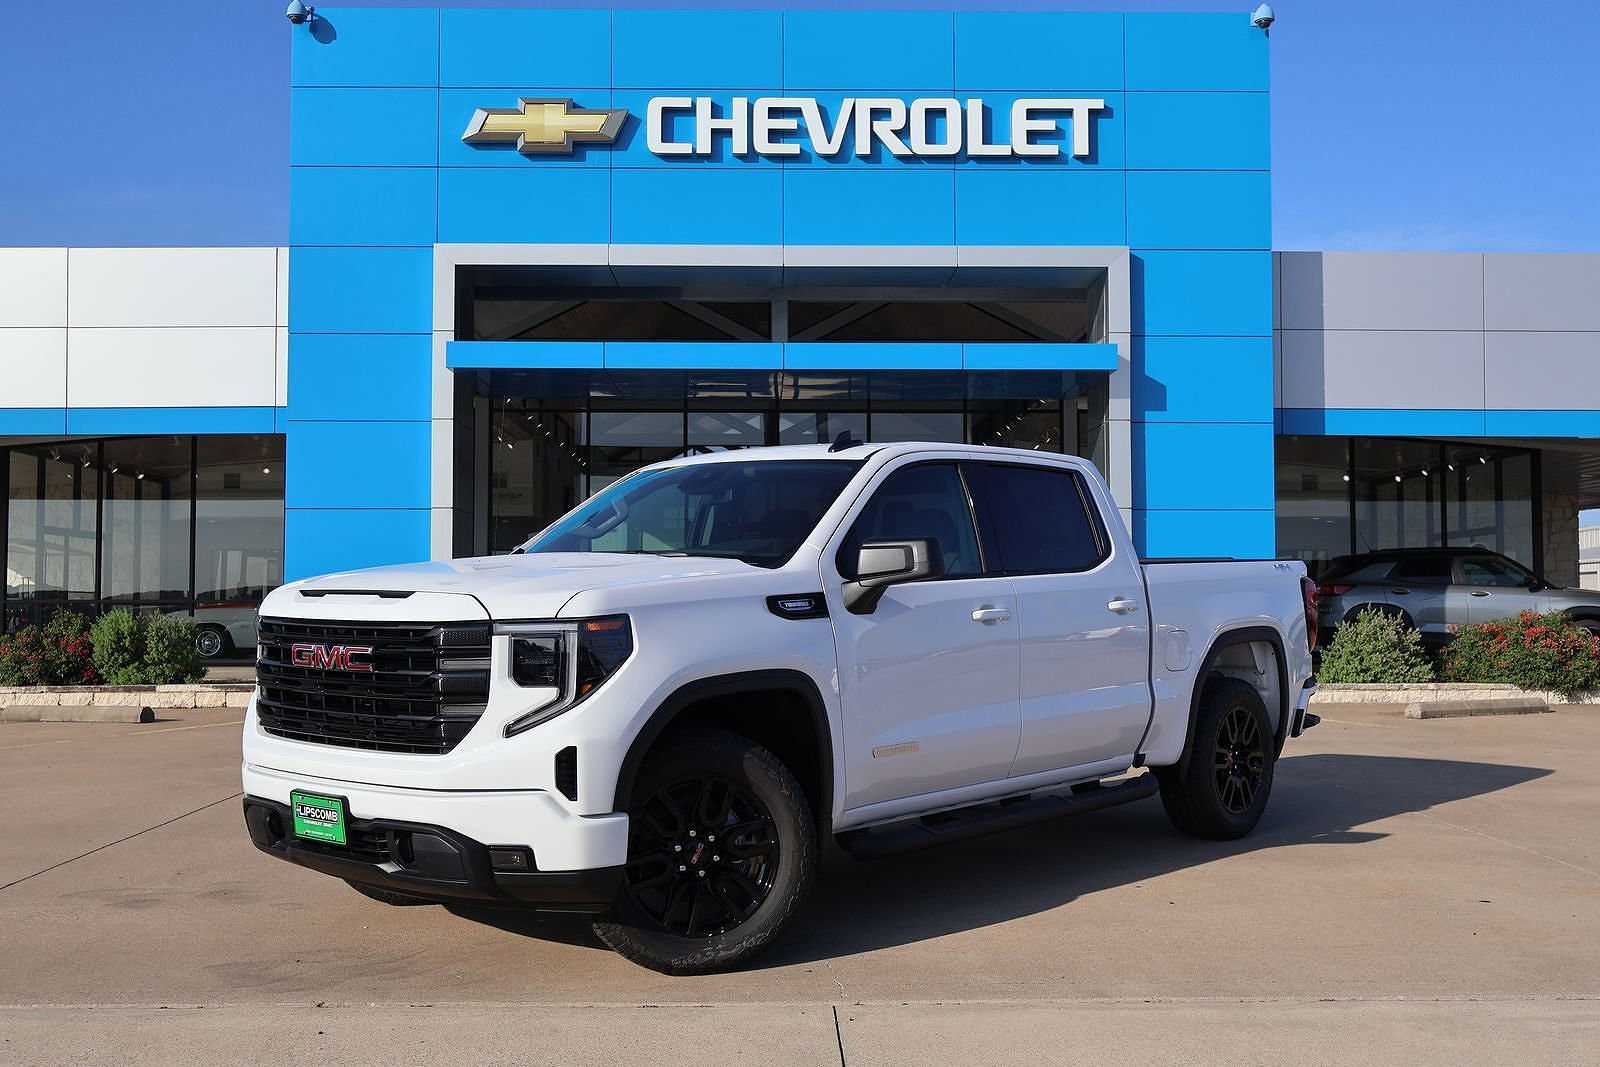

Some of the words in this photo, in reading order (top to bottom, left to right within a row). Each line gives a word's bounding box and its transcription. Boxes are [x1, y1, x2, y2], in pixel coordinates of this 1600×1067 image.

[646, 97, 1106, 158] CHEVROLET
[291, 643, 374, 673] GMC
[299, 805, 338, 822] LIPSCOMB
